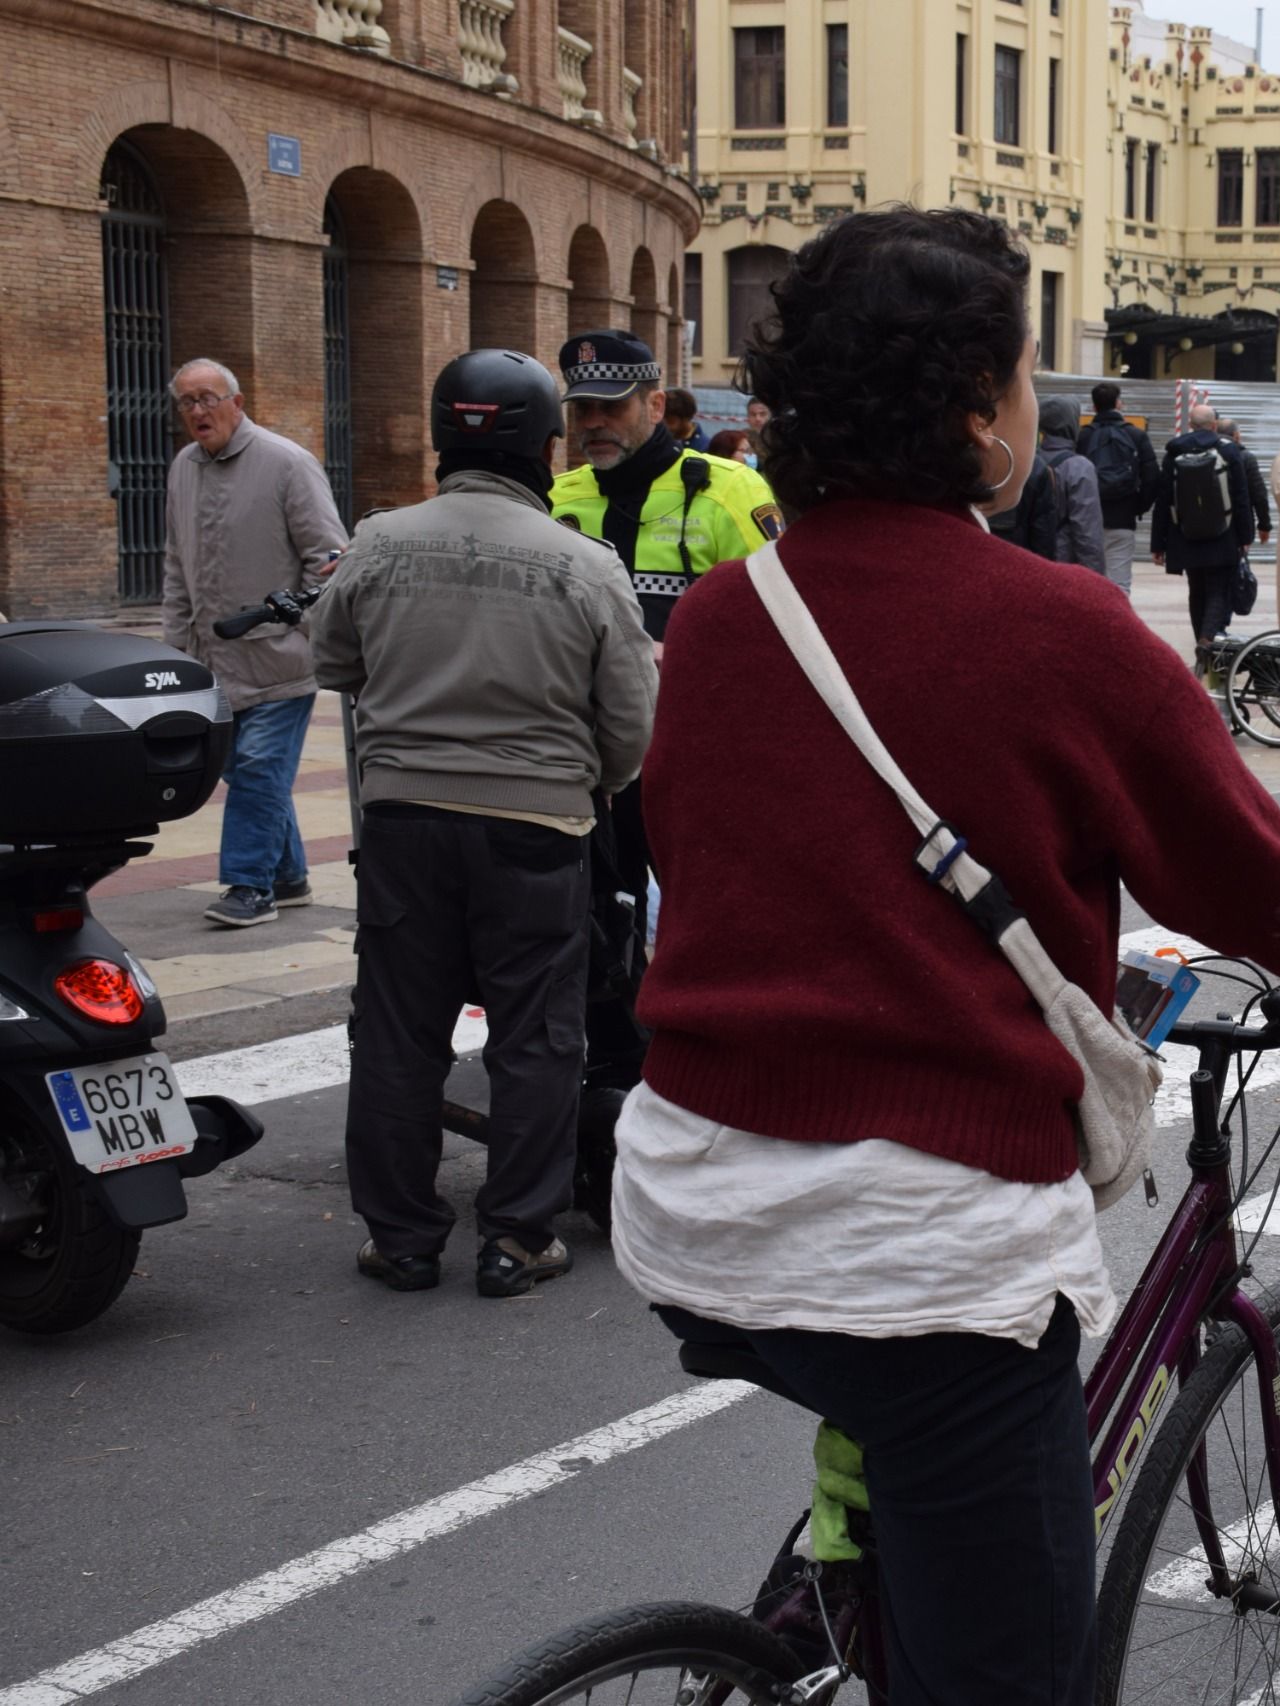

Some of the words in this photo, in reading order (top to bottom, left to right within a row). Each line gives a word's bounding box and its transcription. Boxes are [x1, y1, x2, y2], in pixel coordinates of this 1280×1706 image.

[69, 1108, 81, 1122] E
[82, 1066, 173, 1115] 6673
[95, 1107, 167, 1156] MBW
[1095, 1363, 1169, 1536] NOR
